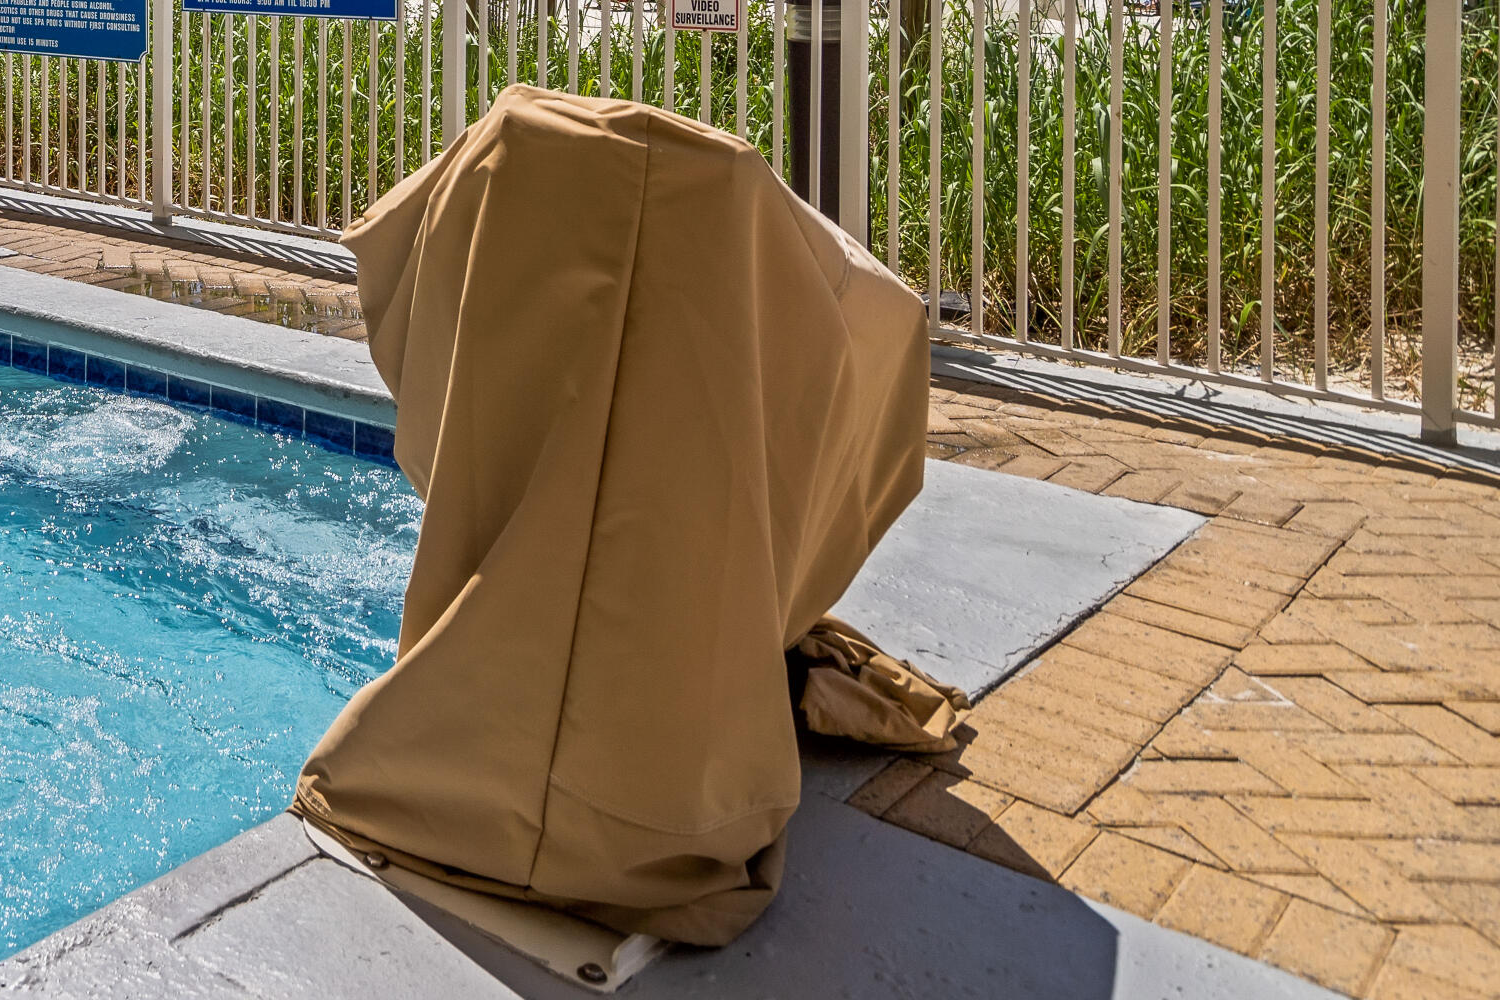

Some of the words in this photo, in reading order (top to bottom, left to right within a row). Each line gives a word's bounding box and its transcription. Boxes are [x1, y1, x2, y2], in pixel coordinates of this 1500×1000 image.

[320, 0, 330, 8] PM
[691, 0, 719, 12] VIDEO
[100, 12, 135, 21] DROWSINESS
[676, 13, 735, 26] SURVEILLANCE
[106, 23, 140, 32] CONSULTING
[36, 39, 58, 47] MINUTES
